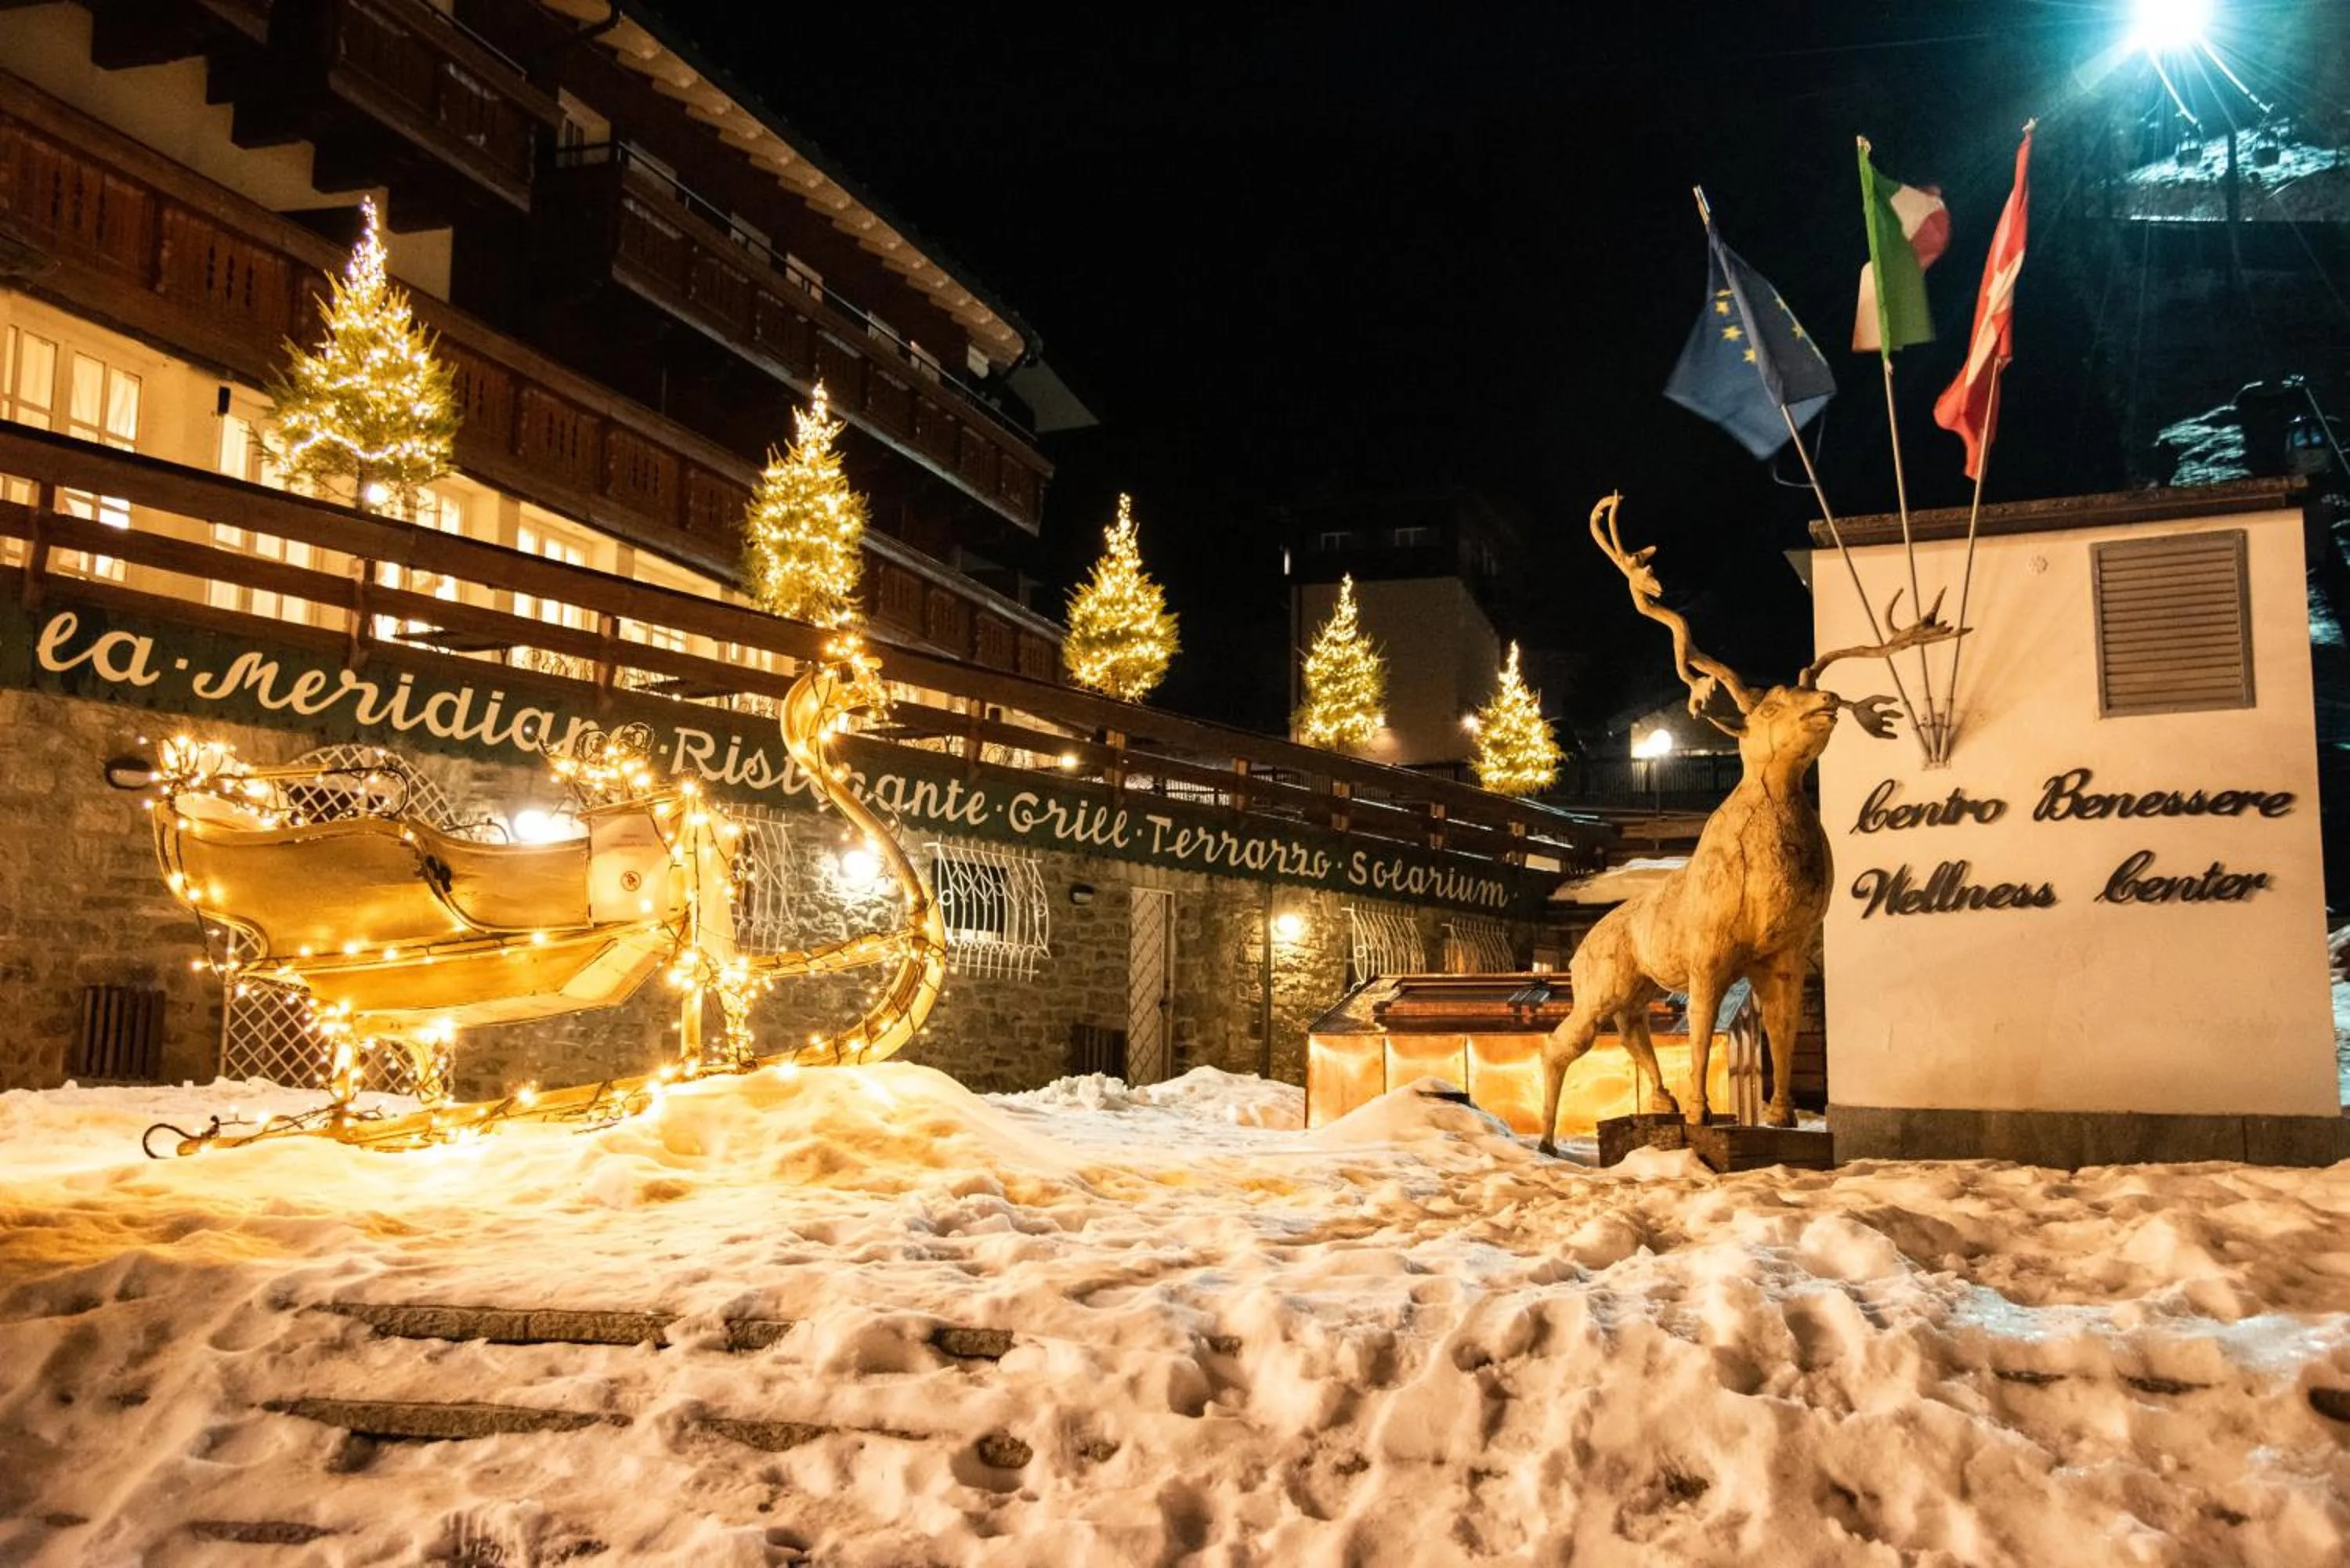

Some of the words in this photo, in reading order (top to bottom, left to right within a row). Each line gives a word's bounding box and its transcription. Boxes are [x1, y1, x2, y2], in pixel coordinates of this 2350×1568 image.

[1849, 779, 2006, 835] Centro
[2032, 768, 2295, 822] Benessere
[1008, 791, 1130, 849] Grill
[1347, 850, 1509, 909] Solarium
[1850, 860, 2055, 919] Wellness
[2094, 850, 2269, 904] Center
